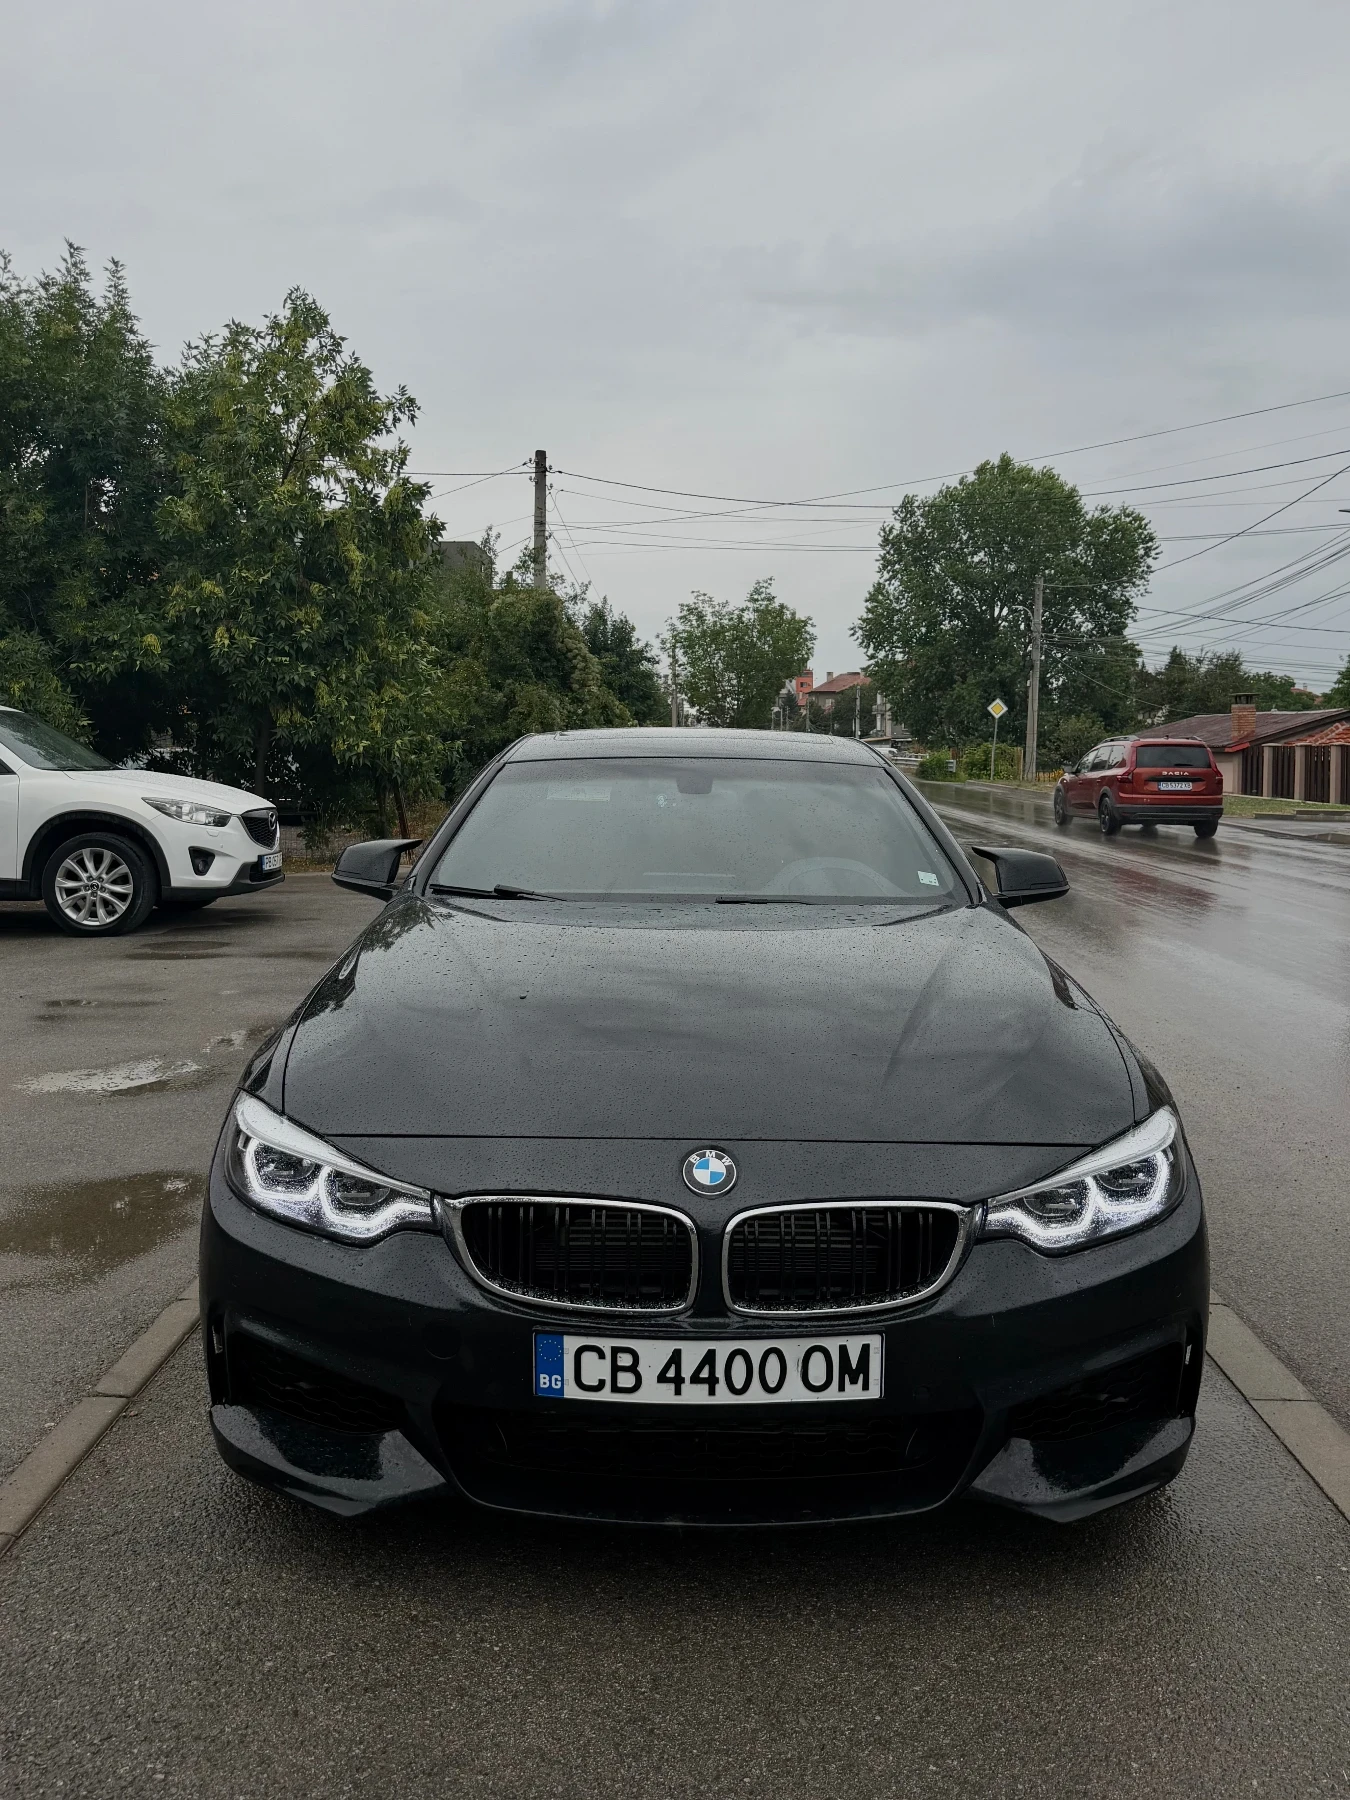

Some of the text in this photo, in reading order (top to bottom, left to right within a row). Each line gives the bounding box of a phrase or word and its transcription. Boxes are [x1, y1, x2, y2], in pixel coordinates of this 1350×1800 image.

[689, 1151, 733, 1166] BMW
[573, 1343, 871, 1396] CB 4400 OM
[539, 1374, 562, 1389] BG
